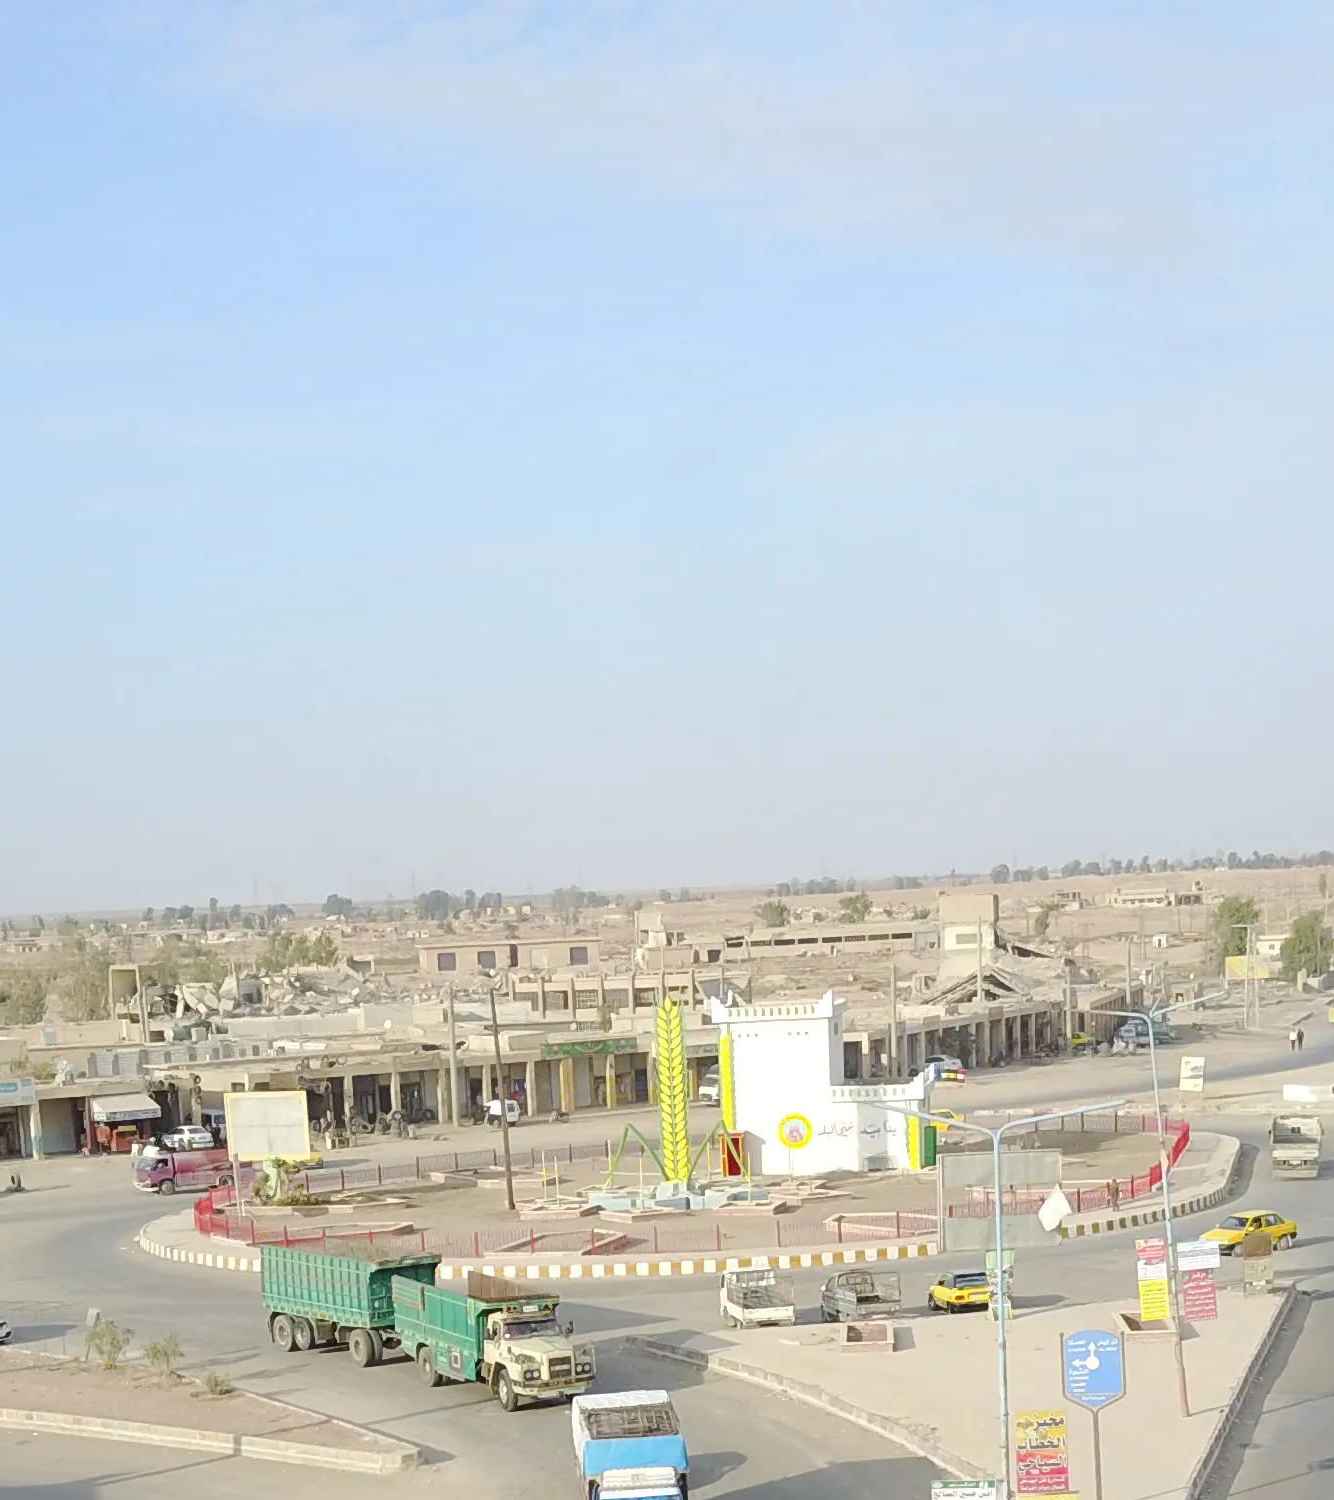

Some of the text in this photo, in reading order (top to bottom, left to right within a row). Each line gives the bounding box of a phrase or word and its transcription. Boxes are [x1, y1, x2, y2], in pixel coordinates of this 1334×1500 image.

[1034, 1414, 1065, 1431] مخبز
[1017, 1436, 1066, 1454] الخطاب
[1017, 1454, 1067, 1475] السياحي
